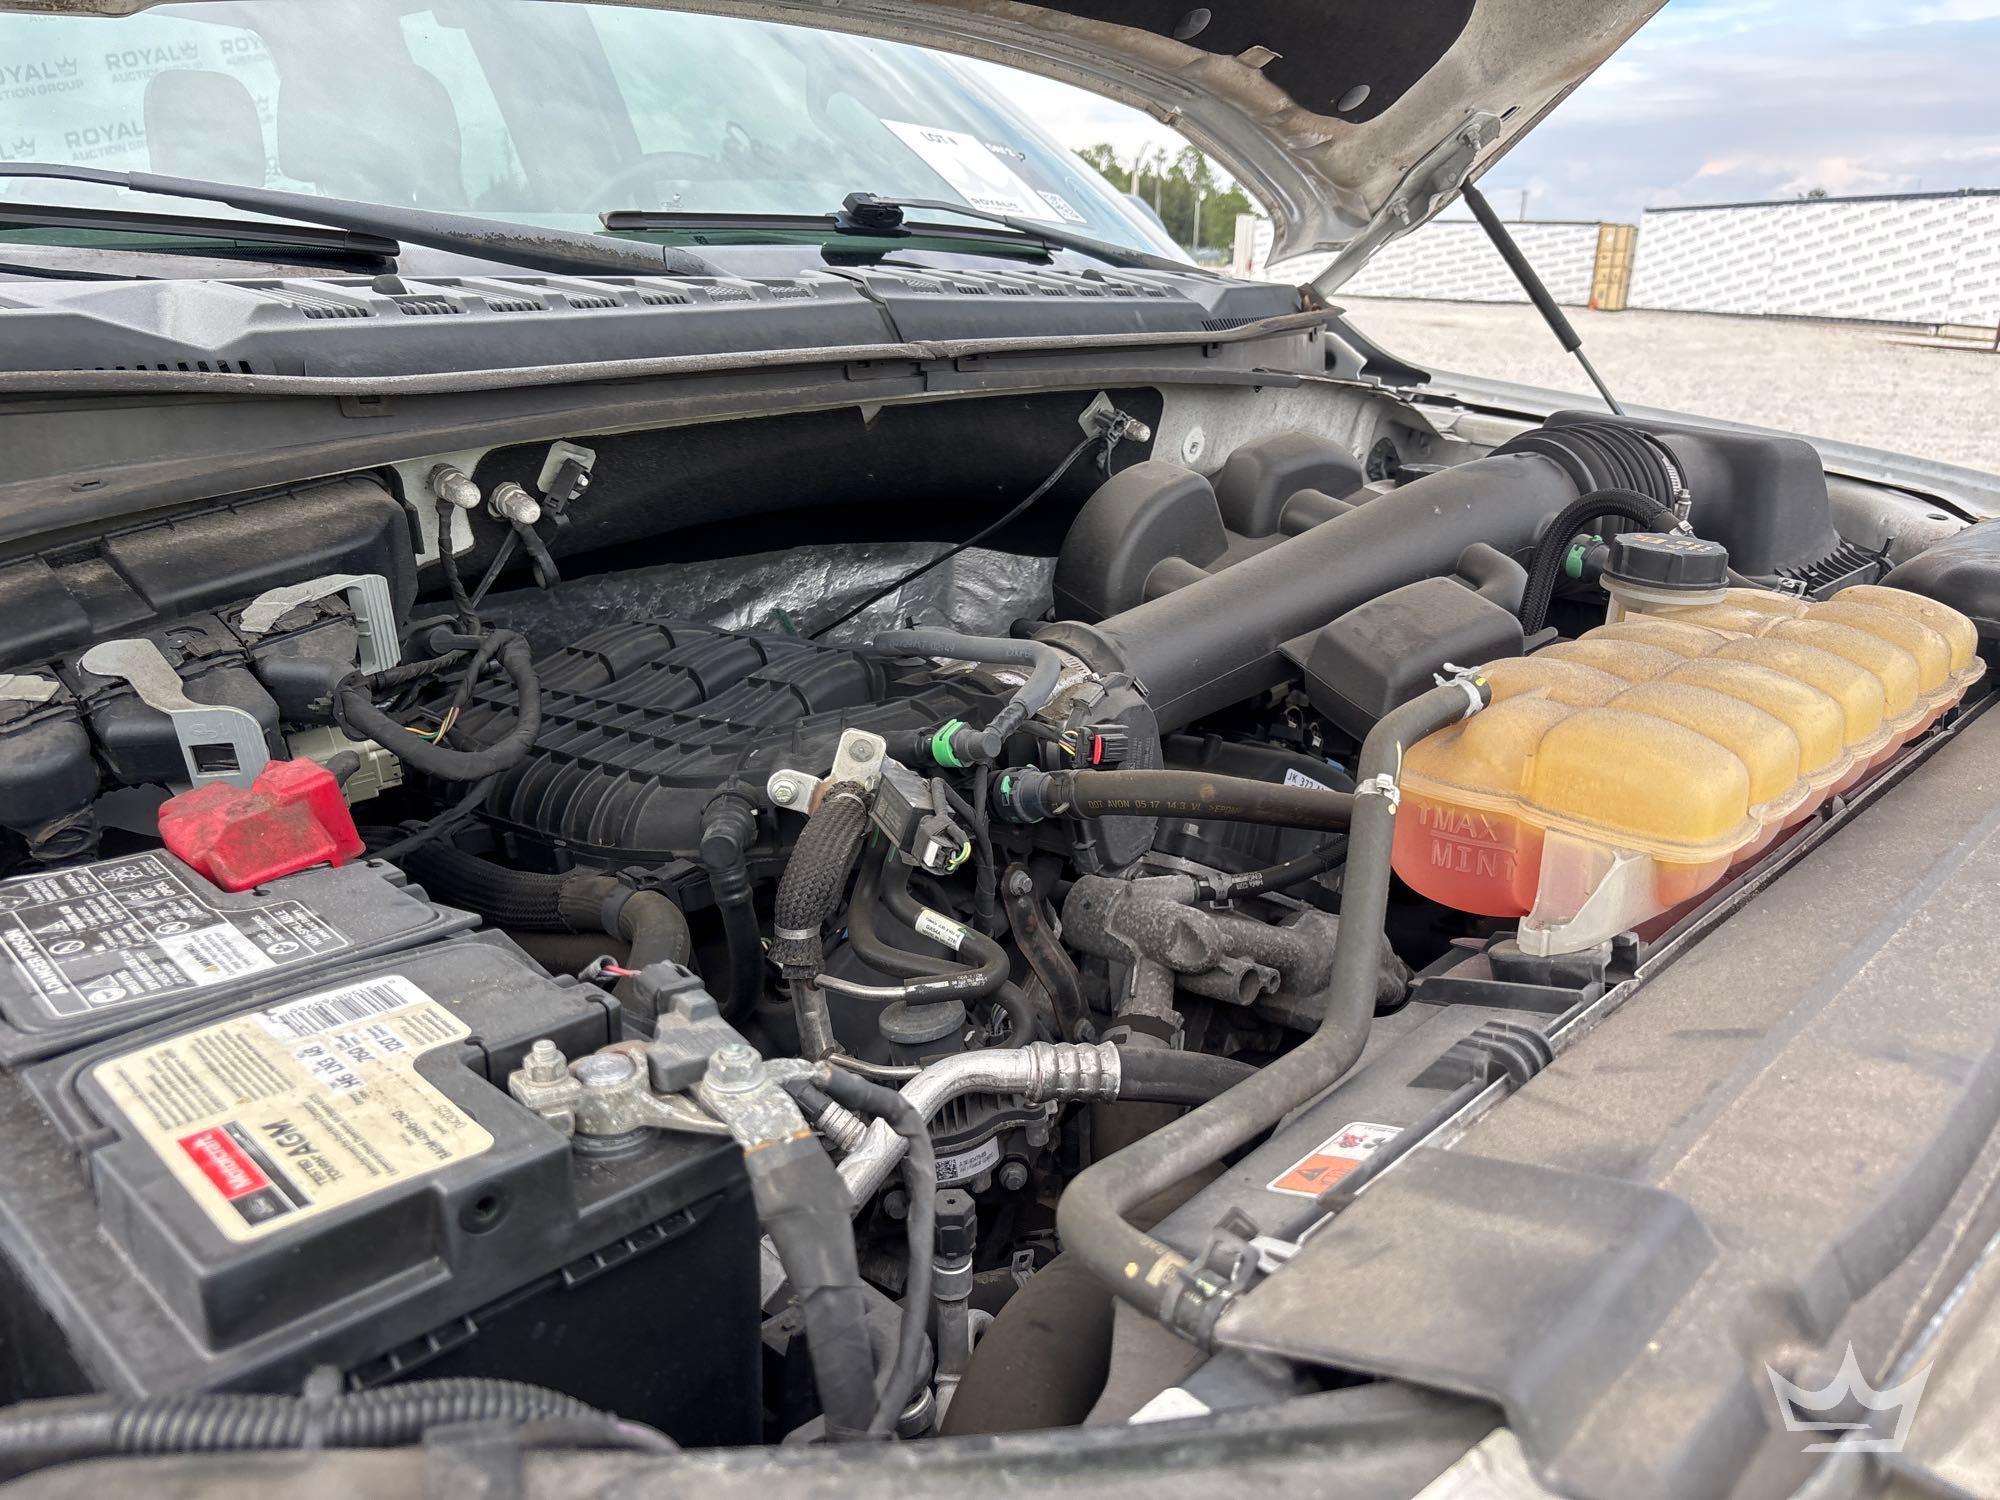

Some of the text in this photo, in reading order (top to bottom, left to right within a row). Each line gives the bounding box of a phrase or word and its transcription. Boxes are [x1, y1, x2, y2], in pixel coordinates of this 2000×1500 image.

[105, 46, 181, 71] ROYAL
[0, 61, 57, 85] YAL
[38, 79, 84, 95] GROUP
[64, 120, 145, 149] ROYAL
[1287, 772, 1297, 783] JK
[1107, 799, 1130, 809] AVON
[1434, 806, 1498, 842] MAX
[1430, 839, 1496, 877] MIN
[126, 891, 144, 900] DO
[139, 886, 160, 898] NOT
[346, 1045, 376, 1063] 760
[378, 1036, 404, 1051] 120
[302, 1045, 362, 1088] H6 LN3 48
[260, 1117, 319, 1161] AGM
[191, 1132, 255, 1190] Motorcraft
[295, 1157, 331, 1186] TESTED
